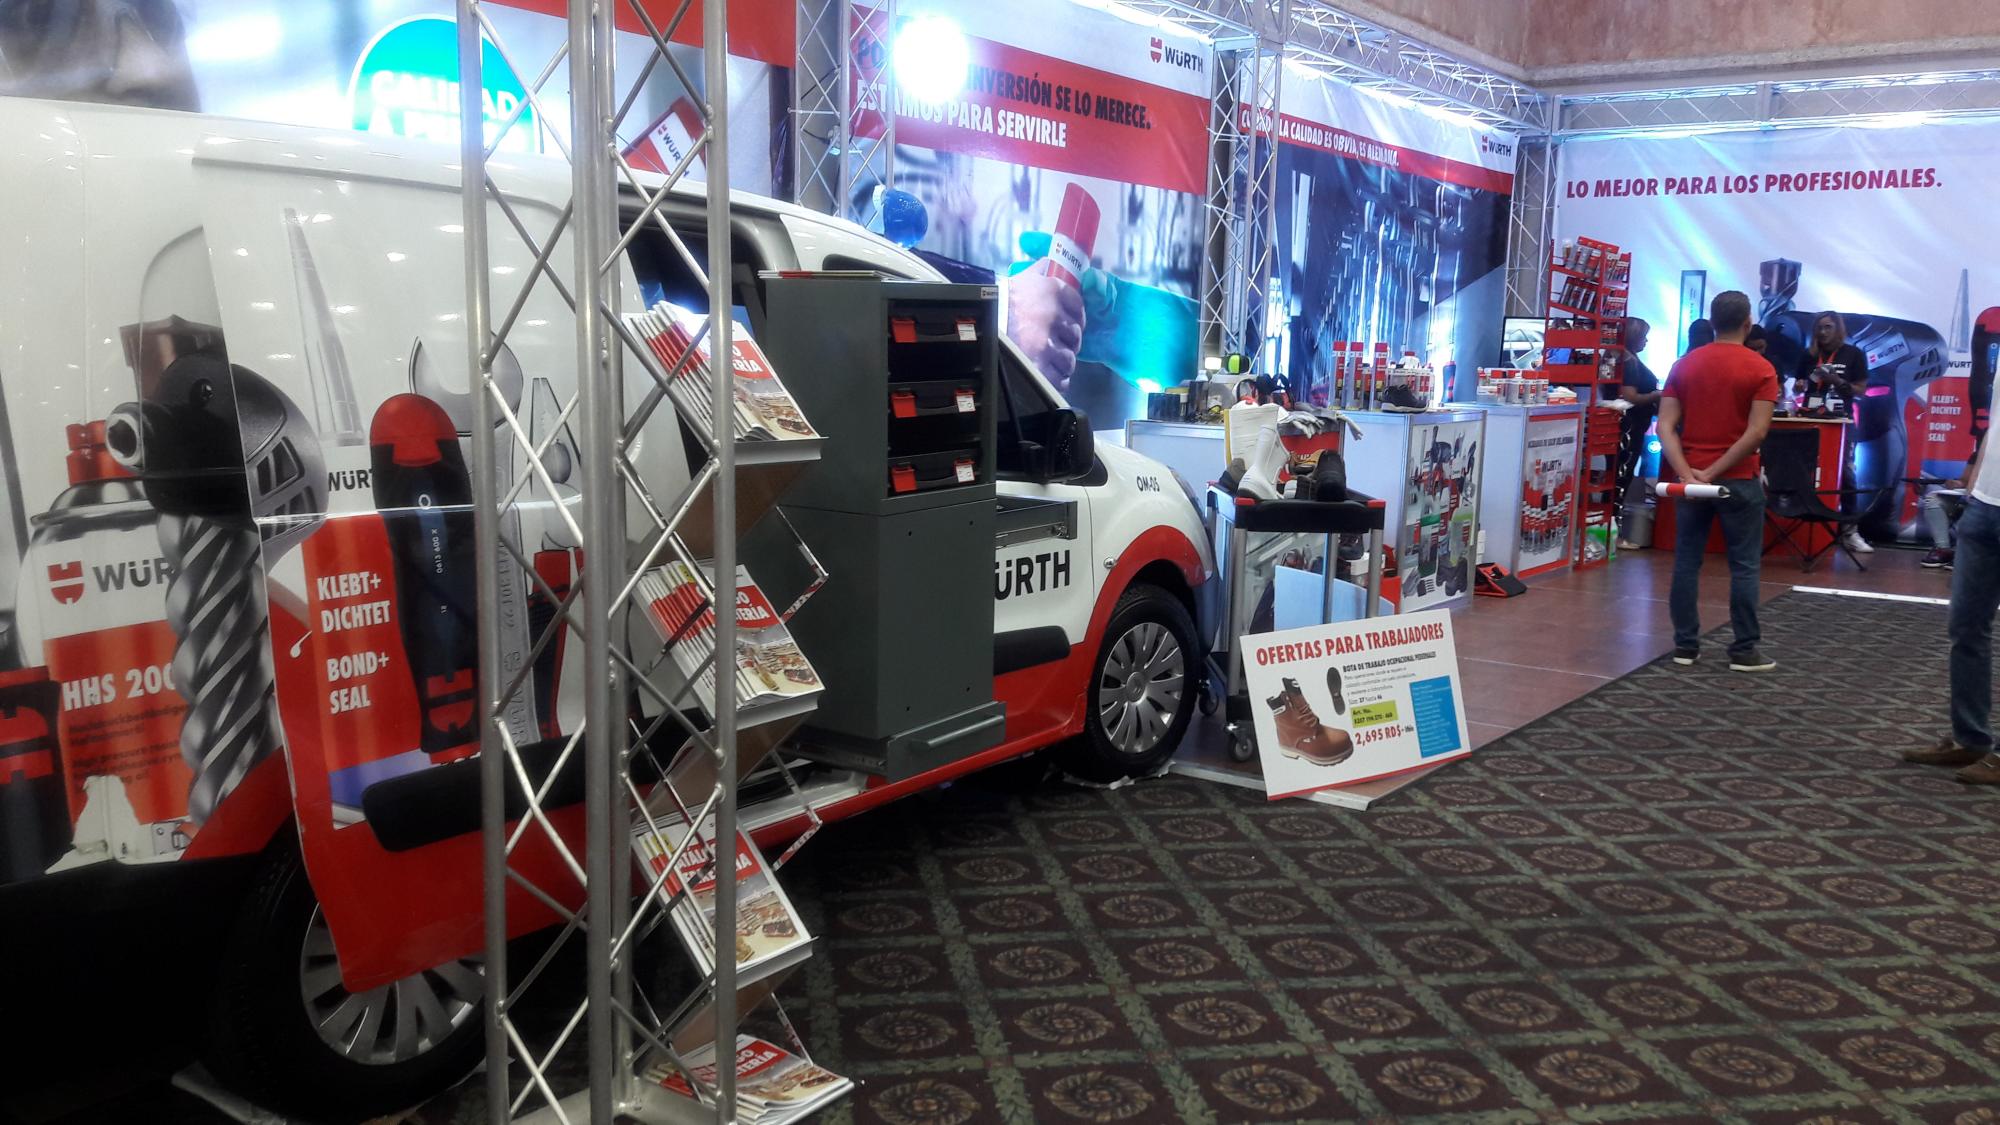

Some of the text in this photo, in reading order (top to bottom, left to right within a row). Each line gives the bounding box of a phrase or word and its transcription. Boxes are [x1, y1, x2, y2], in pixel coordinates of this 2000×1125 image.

[1165, 45, 1204, 74] WÜRTH
[1055, 85, 1071, 113] SE
[1074, 90, 1091, 117] LO
[1095, 95, 1152, 130] MERECE.
[947, 99, 994, 134] PARA
[997, 108, 1067, 148] SERVIRLE
[1279, 118, 1289, 138] LA
[1290, 122, 1323, 146] CALIDAD
[1324, 131, 1333, 148] ES
[1567, 168, 1943, 198] LO MEJOR PARA LOS PROFESIONALES.
[317, 571, 382, 601] KLEBT+
[994, 549, 1071, 601] ÜRTH
[321, 600, 391, 633] DICHTET
[1256, 622, 1444, 666] OFERTAS PARA TRABAJADORES
[327, 651, 389, 682] BOND+
[1358, 661, 1366, 671] DE
[1366, 659, 1386, 669] TRABAJO
[62, 662, 176, 712] HHS 200
[330, 685, 371, 714] SEAL
[1355, 727, 1384, 745] 2,695
